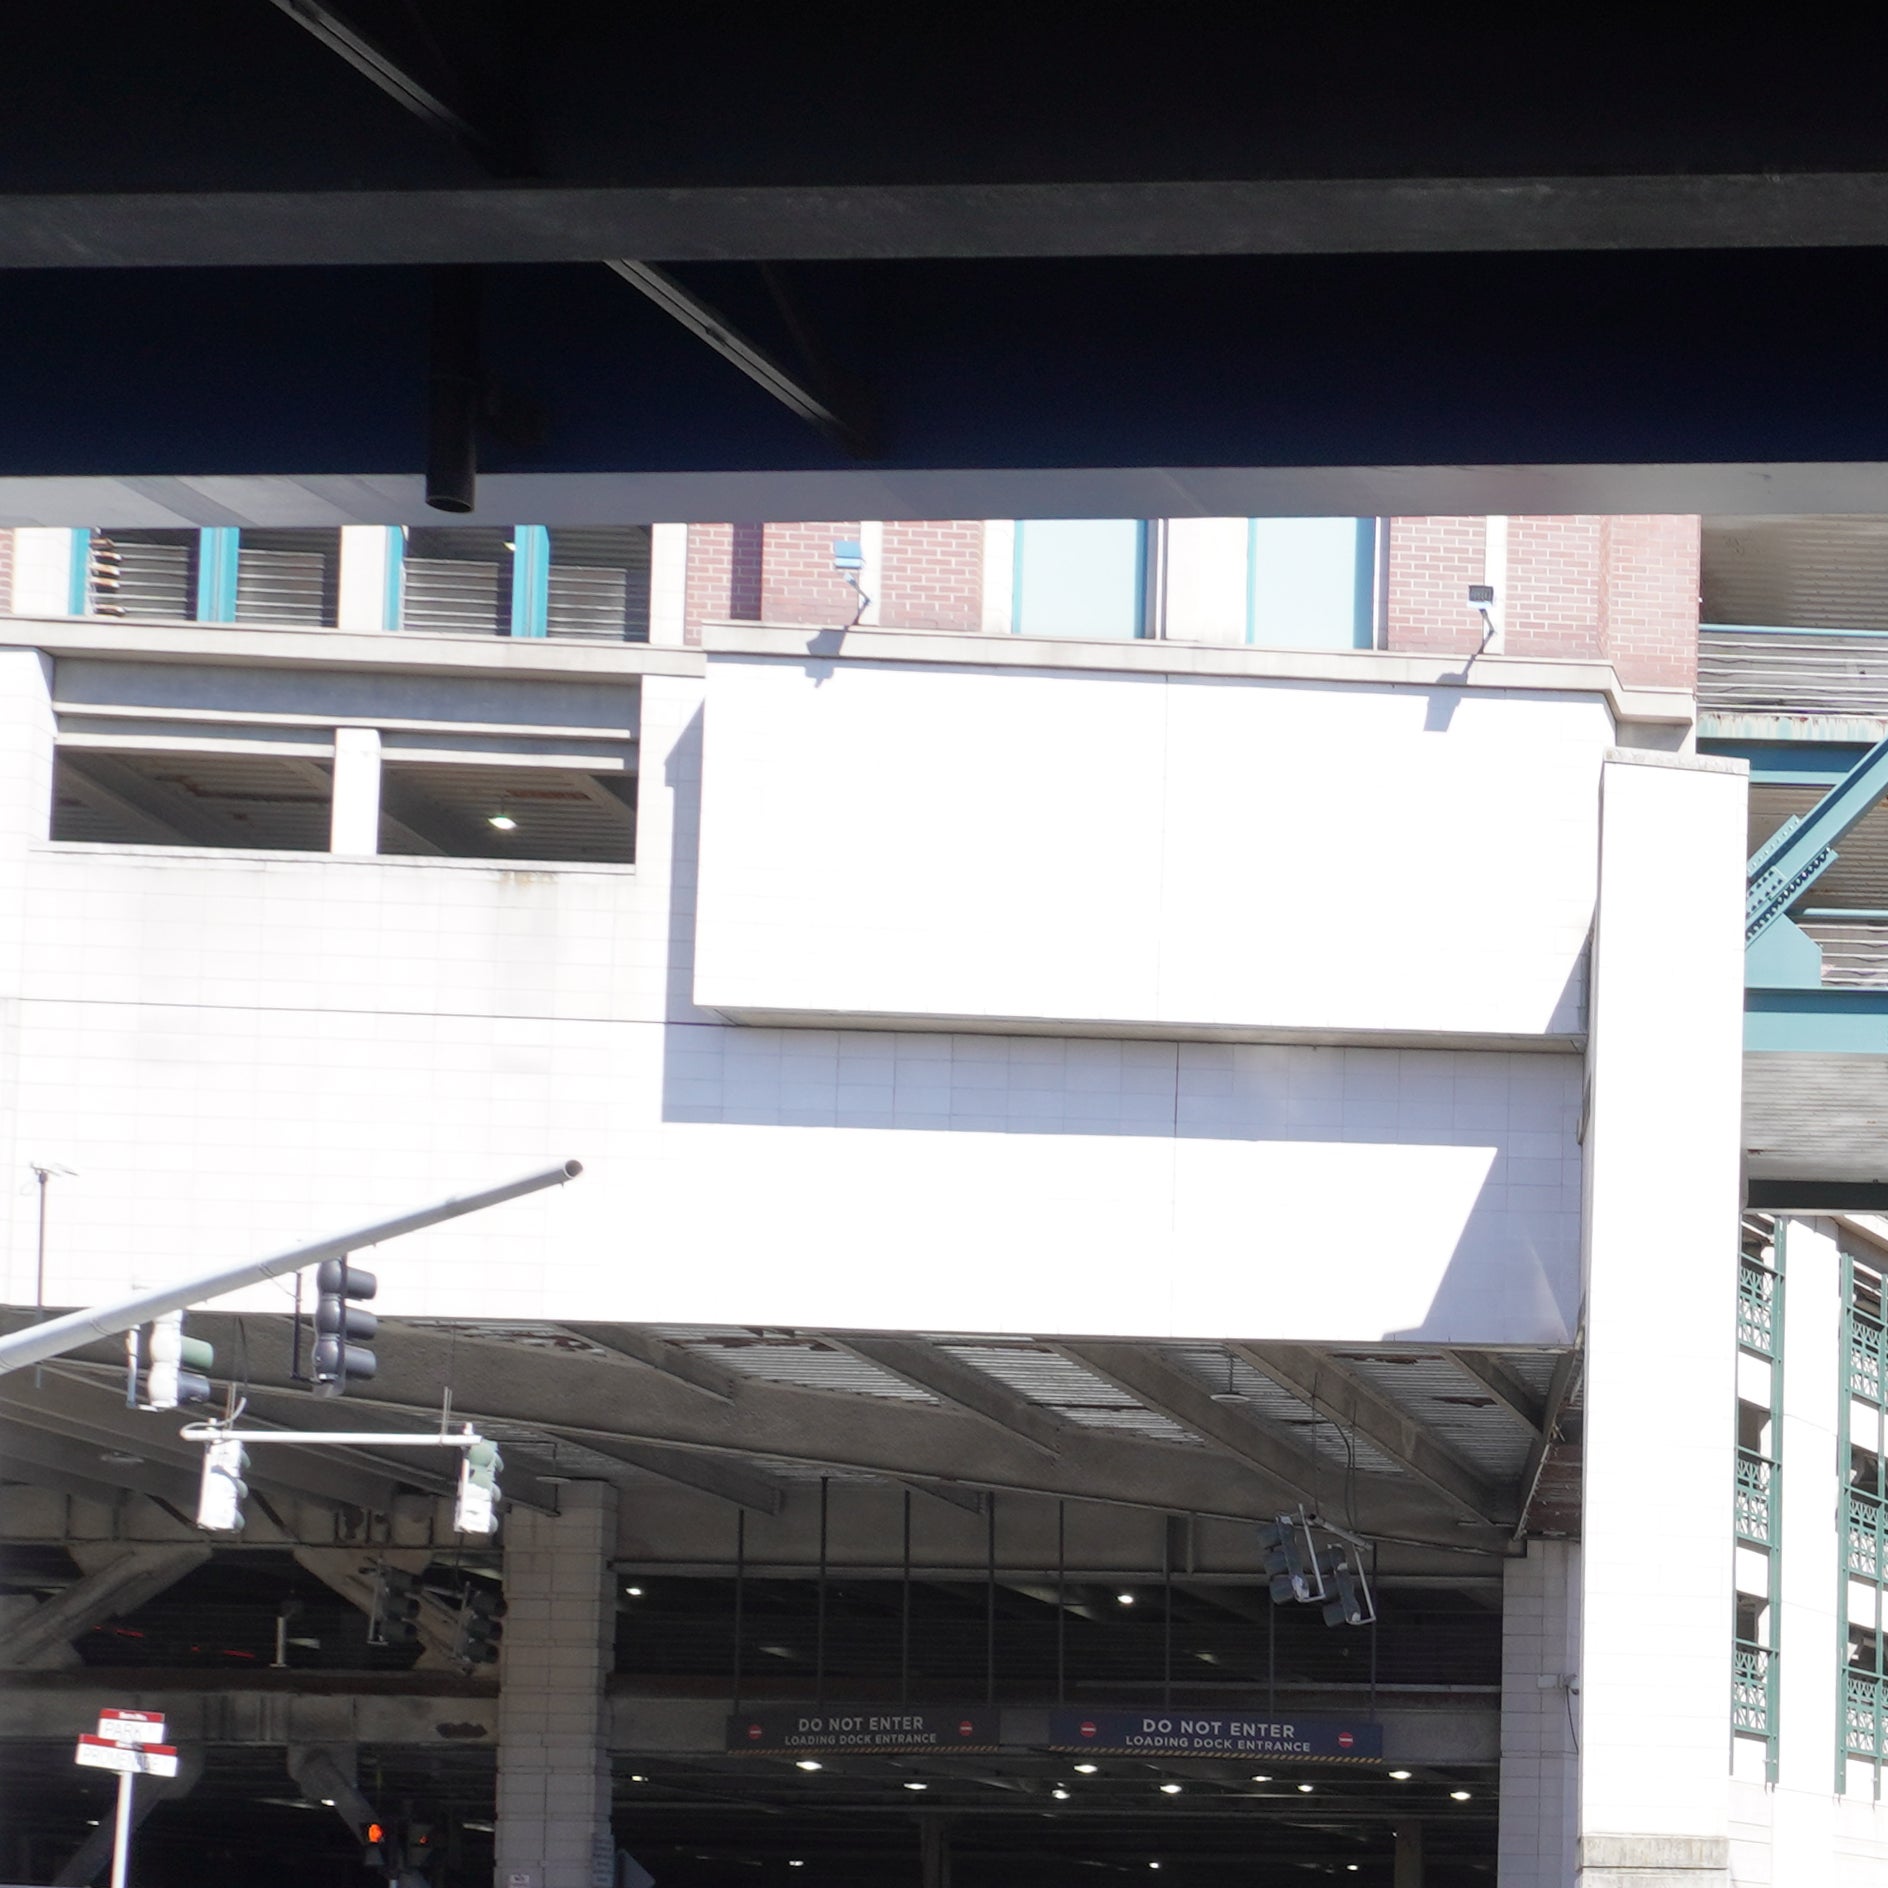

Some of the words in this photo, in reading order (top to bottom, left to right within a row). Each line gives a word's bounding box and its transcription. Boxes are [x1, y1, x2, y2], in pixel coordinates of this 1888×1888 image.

[799, 1718, 823, 1732] DO
[828, 1717, 863, 1731] NOT
[869, 1716, 924, 1730] ENTER
[1142, 1718, 1172, 1733] DO
[1180, 1720, 1222, 1736] NOT
[1230, 1722, 1295, 1739] ENTER
[785, 1733, 836, 1746] LOADING
[839, 1734, 871, 1745] DOCK
[875, 1733, 936, 1745] ENTRANCE
[1125, 1735, 1189, 1748] LOADING
[1194, 1738, 1232, 1750] DOCK
[1237, 1740, 1311, 1752] ENTRANCE
